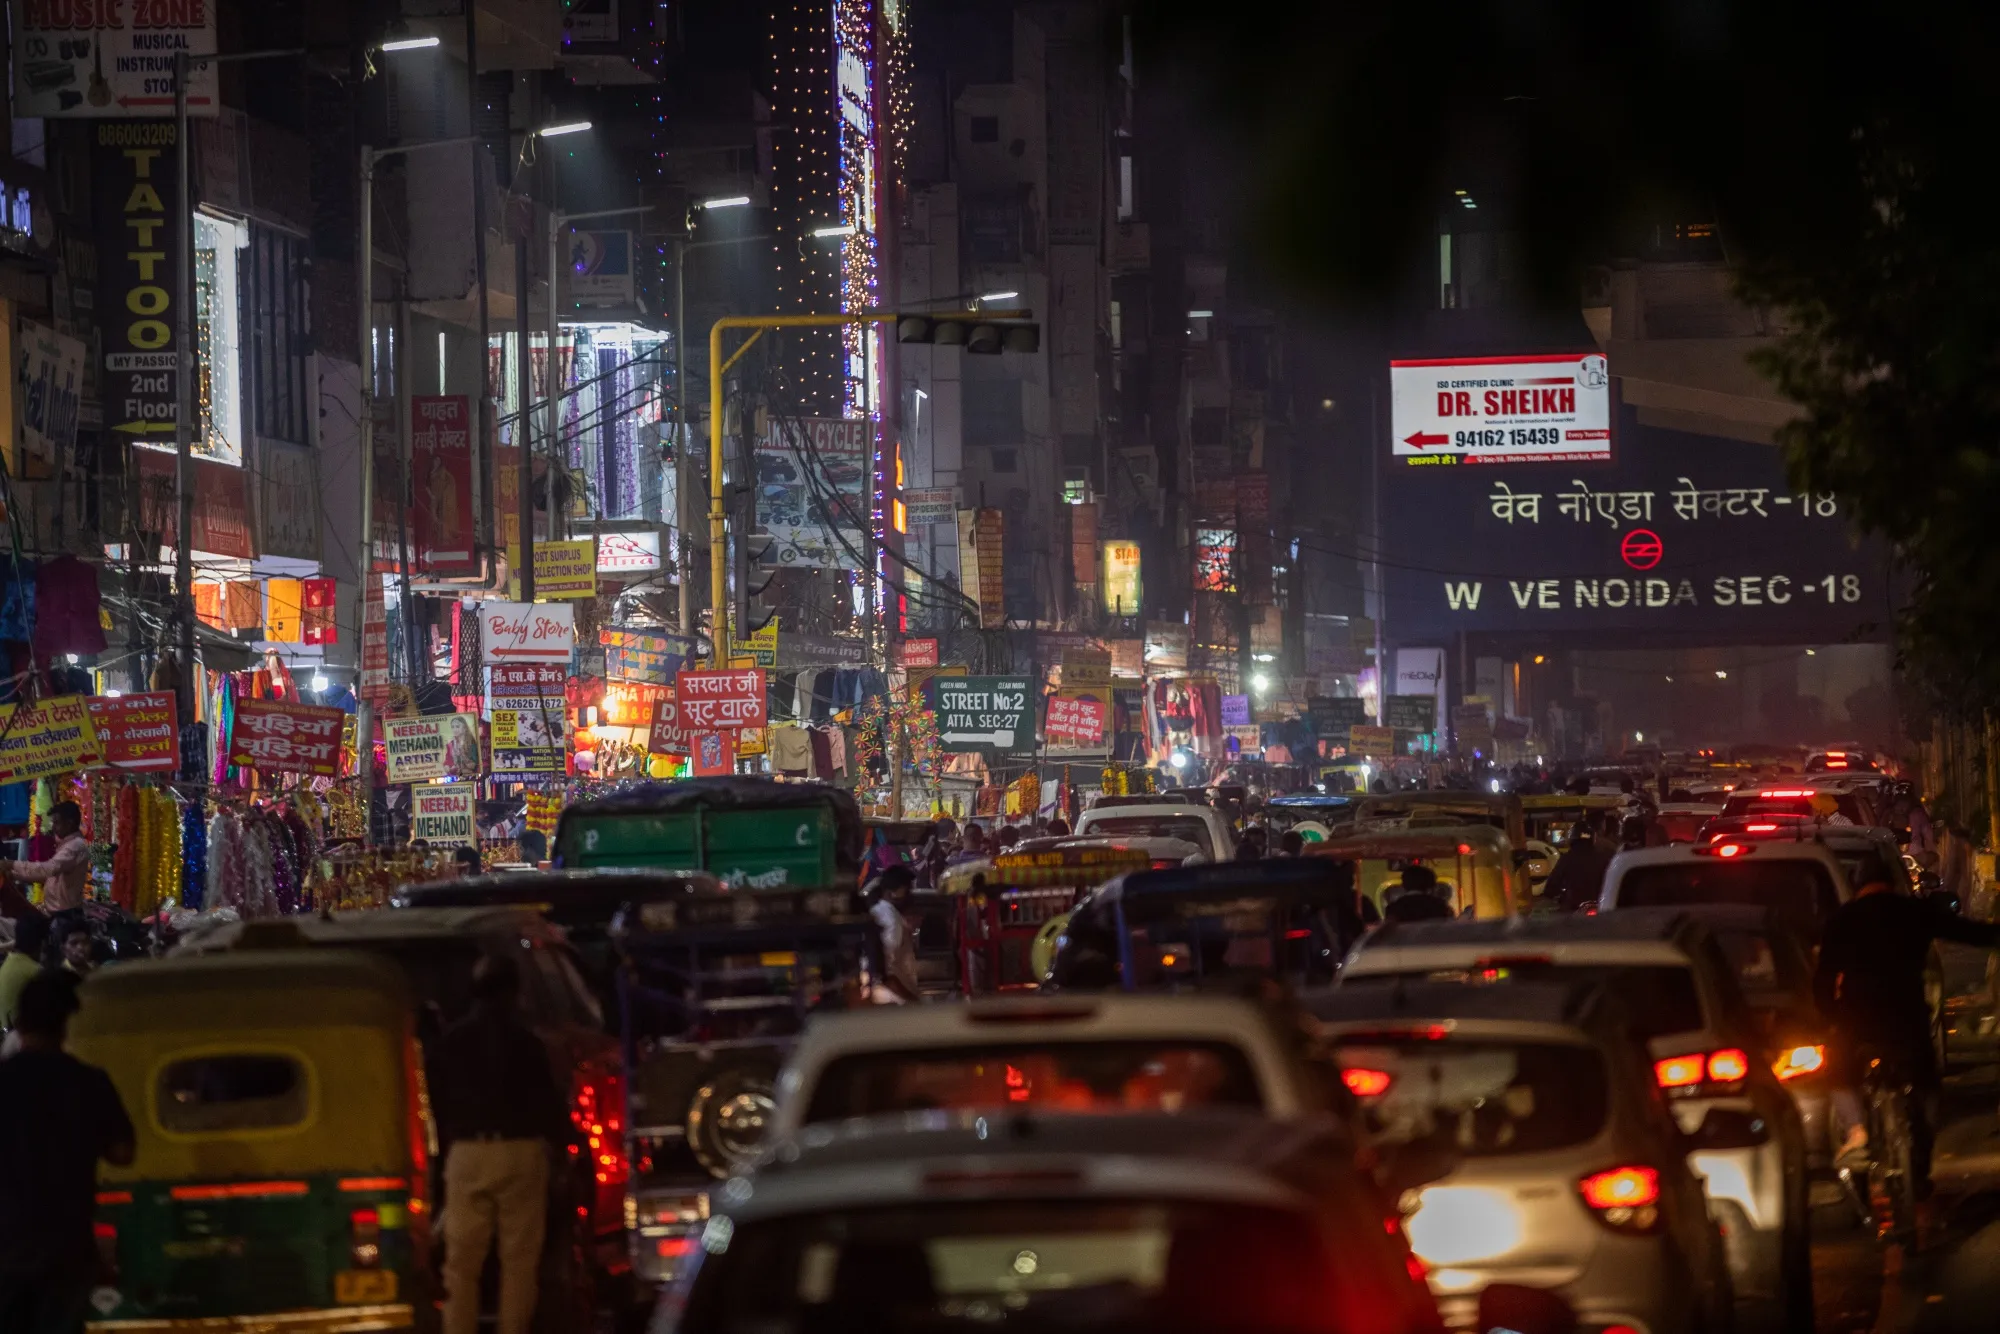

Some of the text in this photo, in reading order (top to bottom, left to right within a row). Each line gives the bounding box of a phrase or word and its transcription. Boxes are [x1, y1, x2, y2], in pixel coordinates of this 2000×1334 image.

[23, 0, 205, 30] MUSIC ZONE
[132, 34, 189, 50] MUSICAL
[99, 124, 176, 146] 886003209
[123, 149, 171, 349] TATTOO
[113, 356, 177, 367] MY PASSIO
[131, 373, 169, 393] 2nd
[1452, 380, 1488, 388] CERTIFIED
[1490, 379, 1515, 387] CLINIC
[125, 399, 177, 418] Floor
[420, 401, 459, 421] चाहत
[1437, 388, 1576, 417] DR. SHEIKH
[1455, 428, 1560, 447] 94162 15439
[905, 494, 929, 504] MOBILE
[1489, 481, 1543, 525] वेव
[1555, 479, 1656, 529] नोएडा
[906, 514, 953, 524] CESSORIES
[550, 549, 581, 561] SURPLUS
[534, 566, 572, 579] OLLECTION
[573, 564, 592, 576] SHOP
[1574, 578, 1698, 608] NOIDA
[488, 615, 570, 645] Baby Store
[683, 671, 759, 694] सरदार जी
[682, 693, 762, 726] सूट वाले
[941, 692, 1025, 711] STREET No:2
[239, 713, 338, 736] चूड़ियाँ
[495, 713, 516, 722] SEX
[947, 713, 1020, 729] ATTA SEC:27
[393, 723, 440, 738] NEERAJ
[25, 747, 60, 760] PILLAR
[236, 736, 335, 760] चूड़ियाँ
[389, 735, 443, 754] MEHANDI
[395, 752, 440, 766] ARTIST
[421, 796, 468, 813] NEERAJ
[416, 816, 471, 838] MEHANDI
[796, 823, 812, 847] C
[430, 840, 469, 850] RTIST
